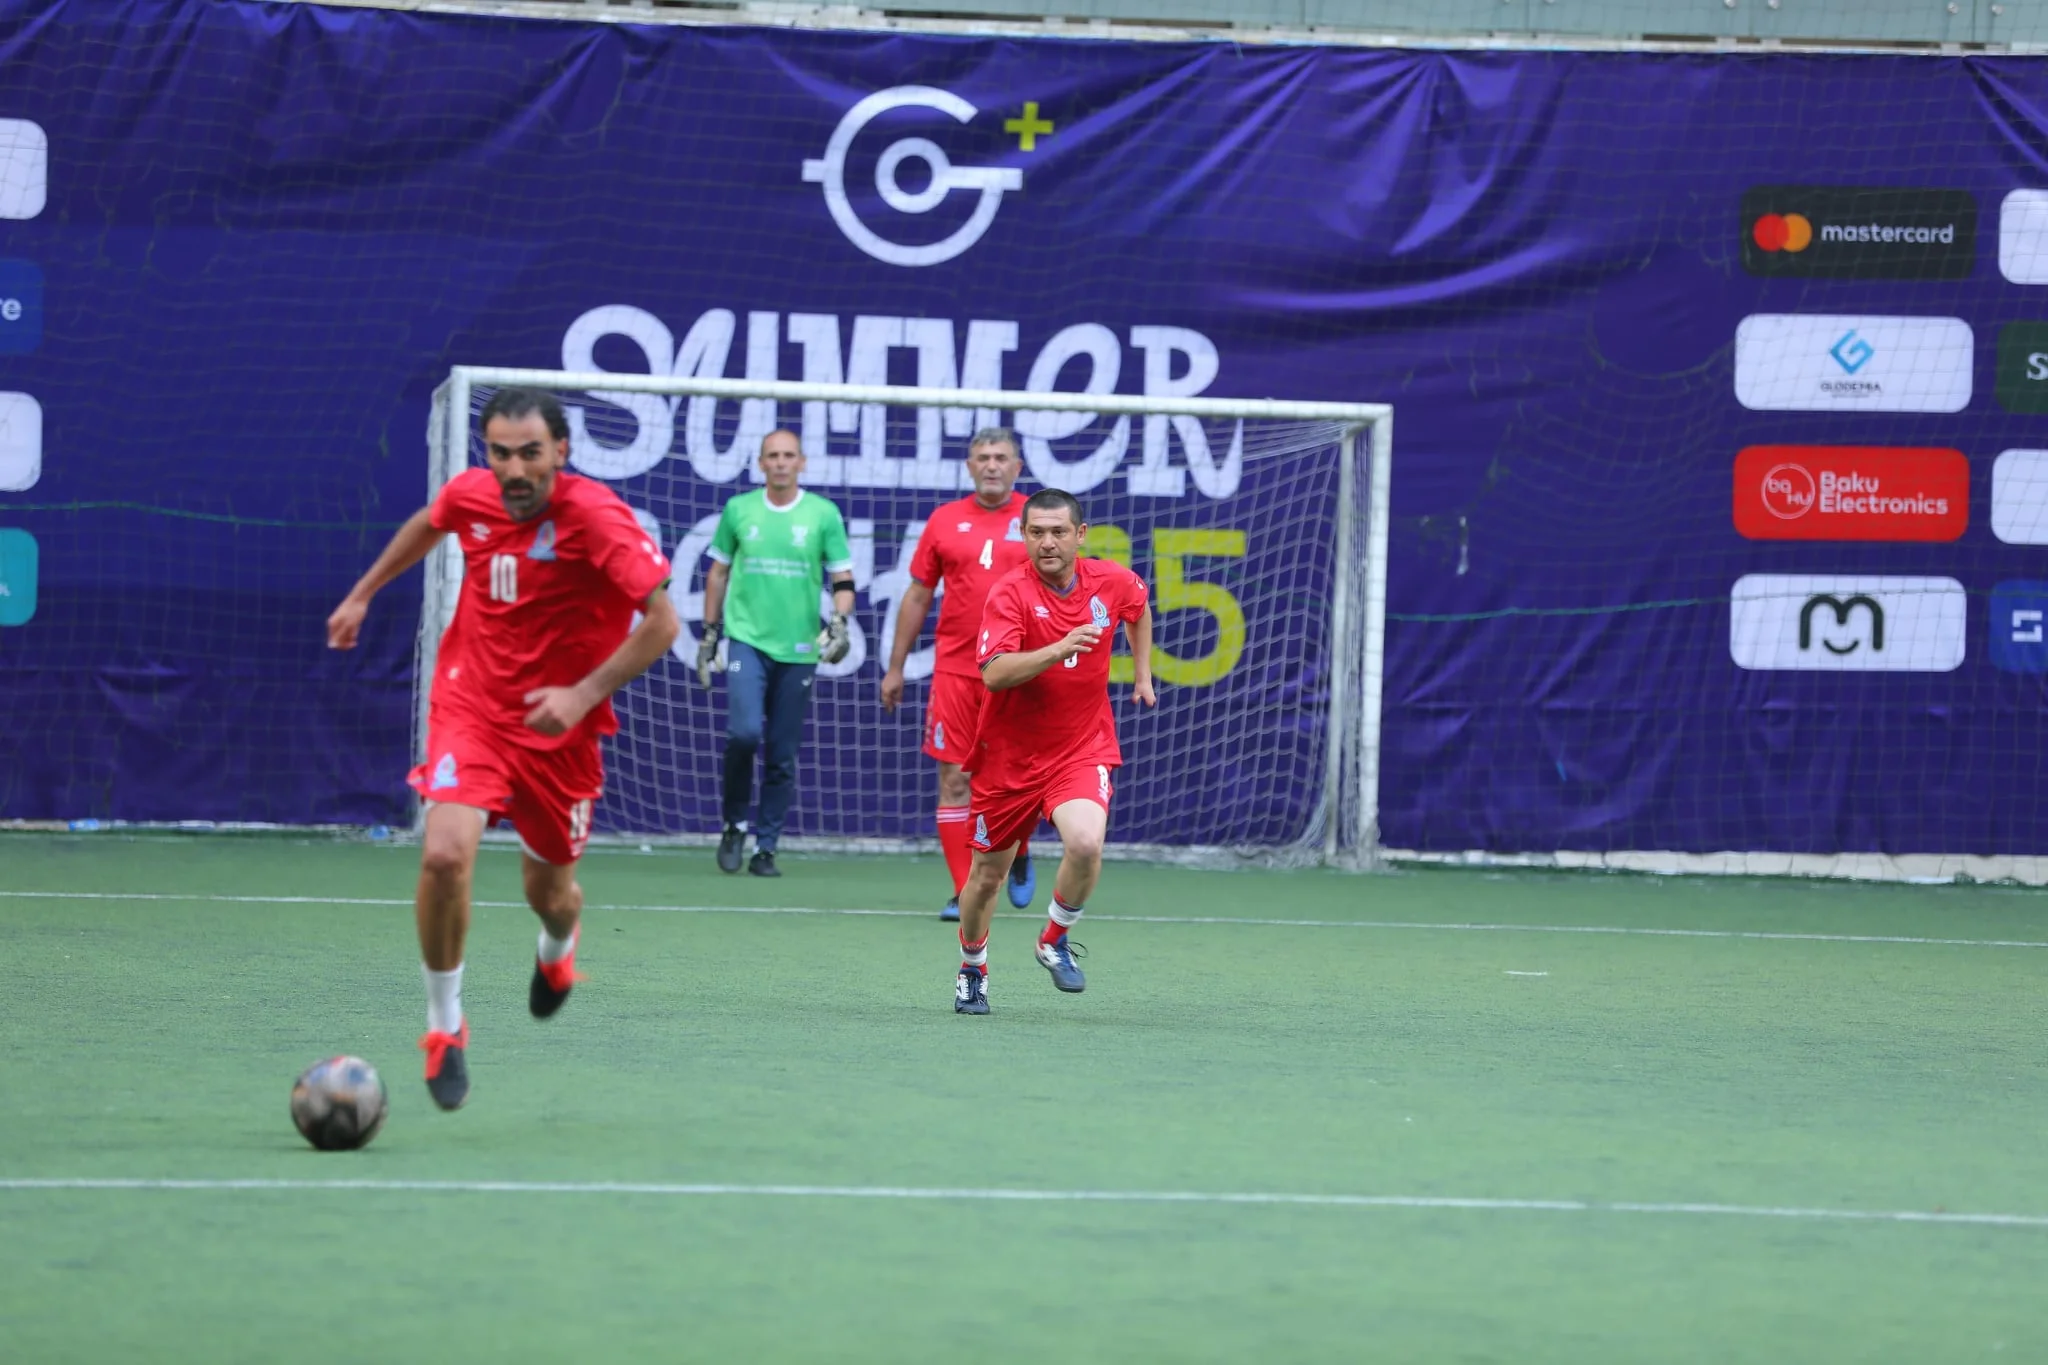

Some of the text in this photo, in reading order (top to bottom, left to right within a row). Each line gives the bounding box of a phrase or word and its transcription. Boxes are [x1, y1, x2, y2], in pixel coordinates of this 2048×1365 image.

[1820, 223, 1954, 244] mastercard
[1819, 470, 1880, 493] Baku
[1819, 493, 1949, 515] Electronics
[978, 539, 994, 570] 4
[489, 553, 518, 603] 10
